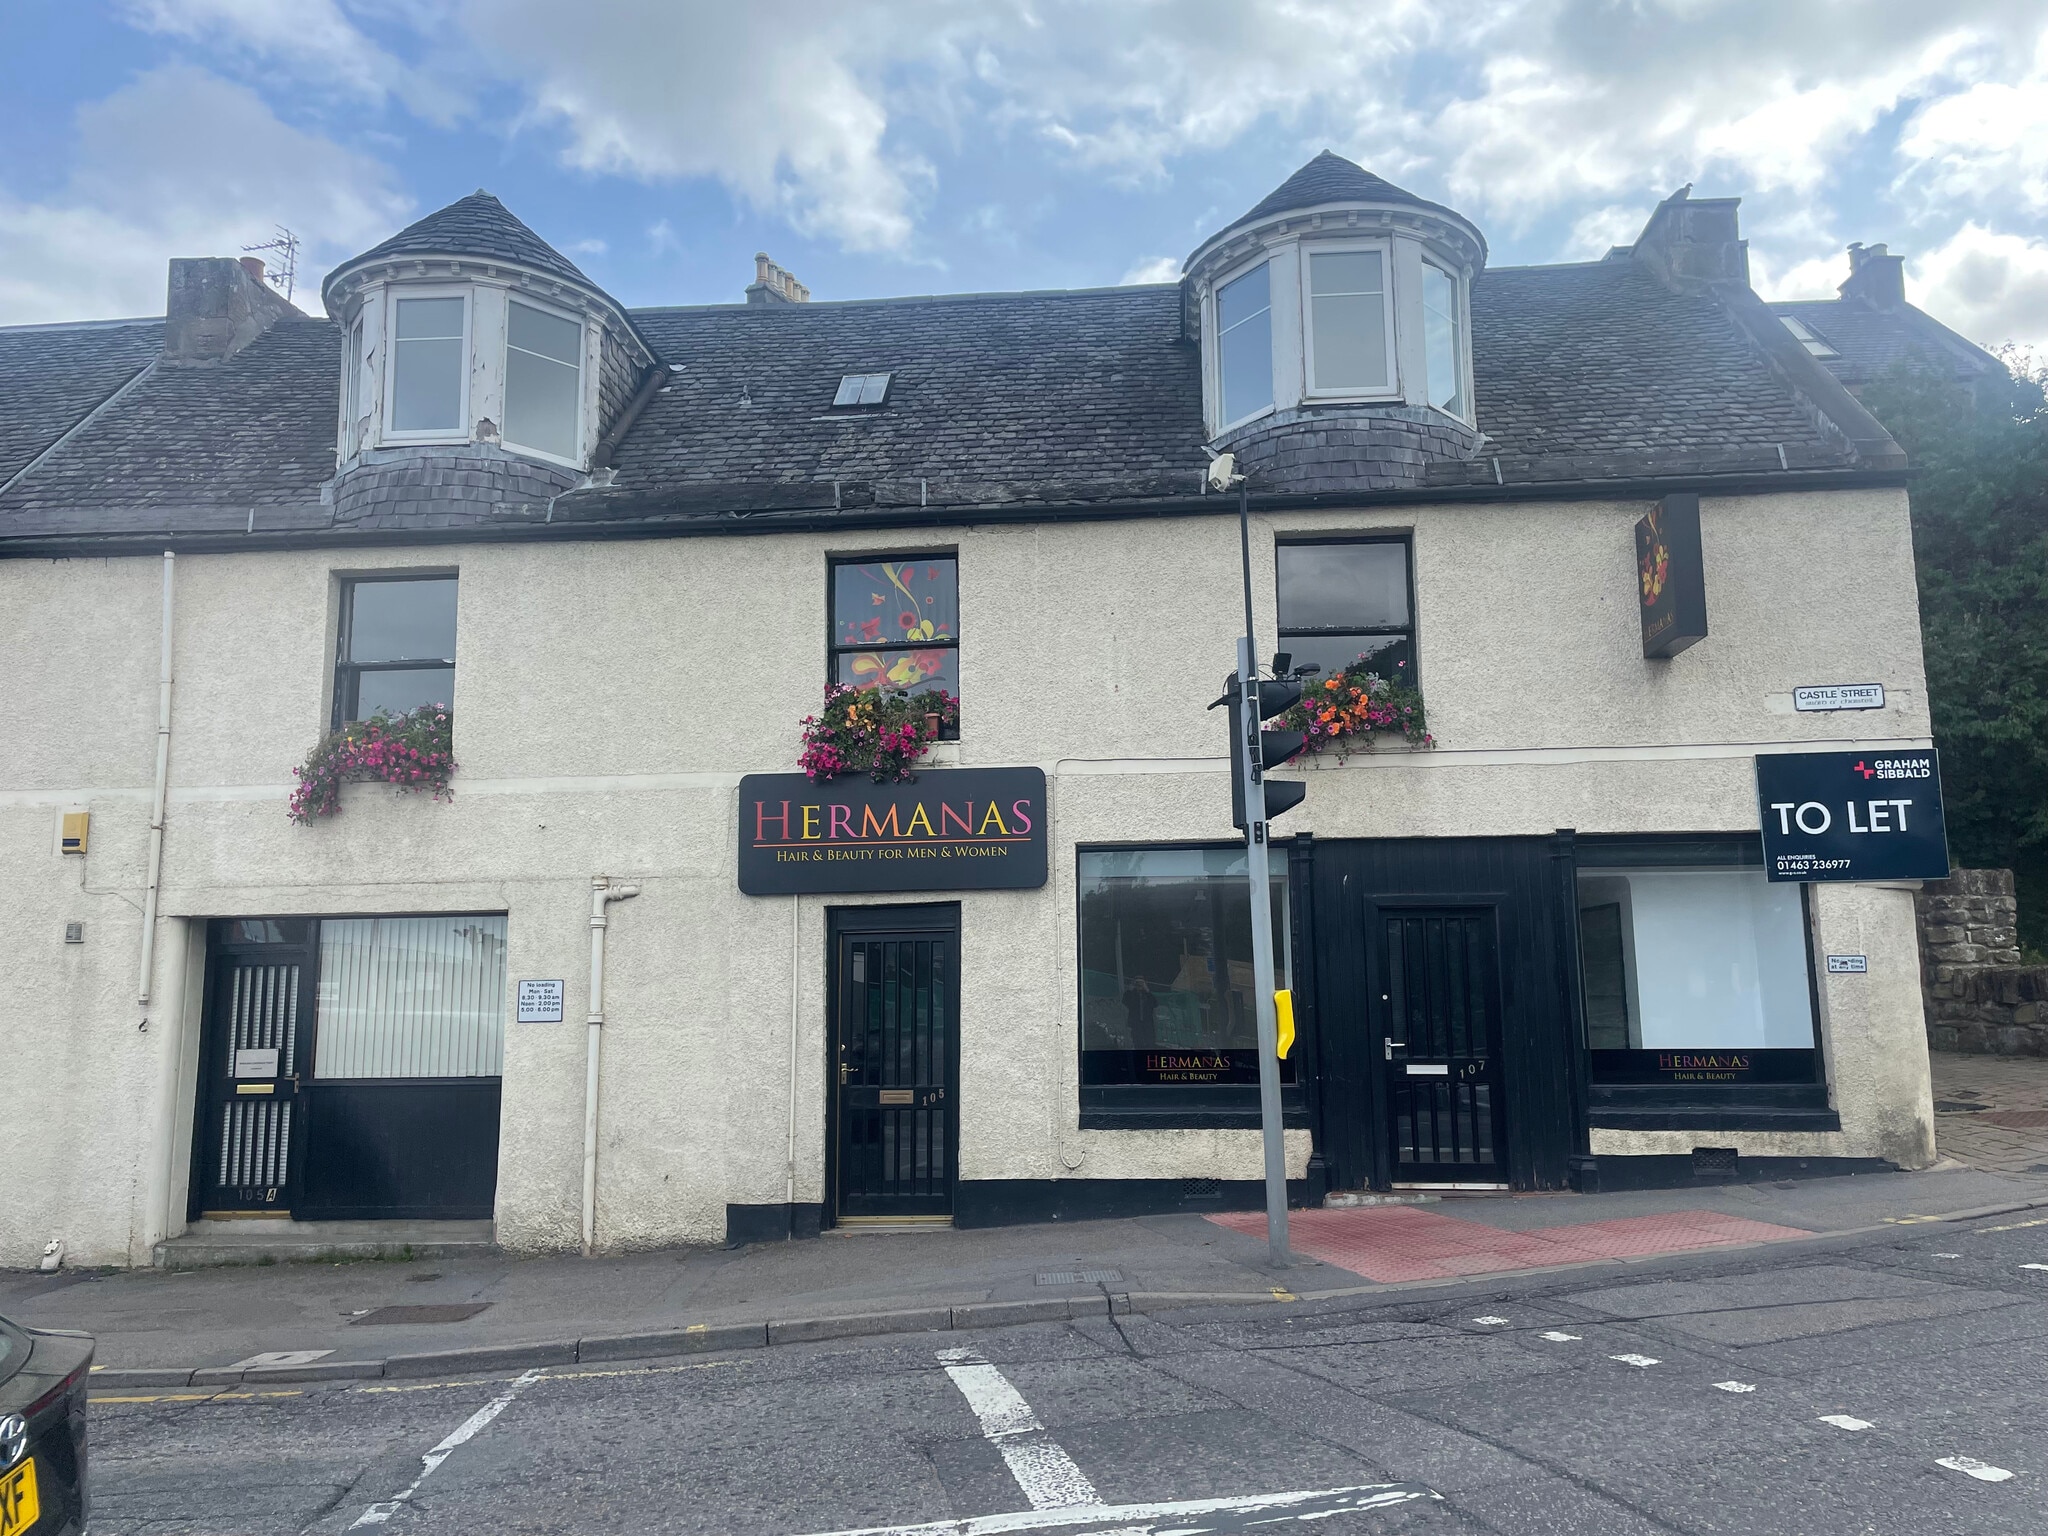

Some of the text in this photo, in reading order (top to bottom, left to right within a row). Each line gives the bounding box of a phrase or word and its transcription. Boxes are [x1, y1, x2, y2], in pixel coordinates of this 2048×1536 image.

[1799, 688, 1878, 700] CASTLE STREET
[1874, 759, 1930, 770] GRAHAM
[1876, 768, 1931, 779] SIBBALD
[753, 799, 1032, 841] HERMANAS
[1771, 799, 1912, 835] TO LET
[813, 849, 823, 861] &
[940, 847, 952, 857] &
[1777, 860, 1851, 870] 01463 236977
[1147, 1055, 1230, 1068] HERMANAS
[1659, 1054, 1749, 1067] HERMANAS
[1460, 1060, 1485, 1079] 107
[1697, 1072, 1703, 1080] &
[923, 1088, 944, 1106] 105
